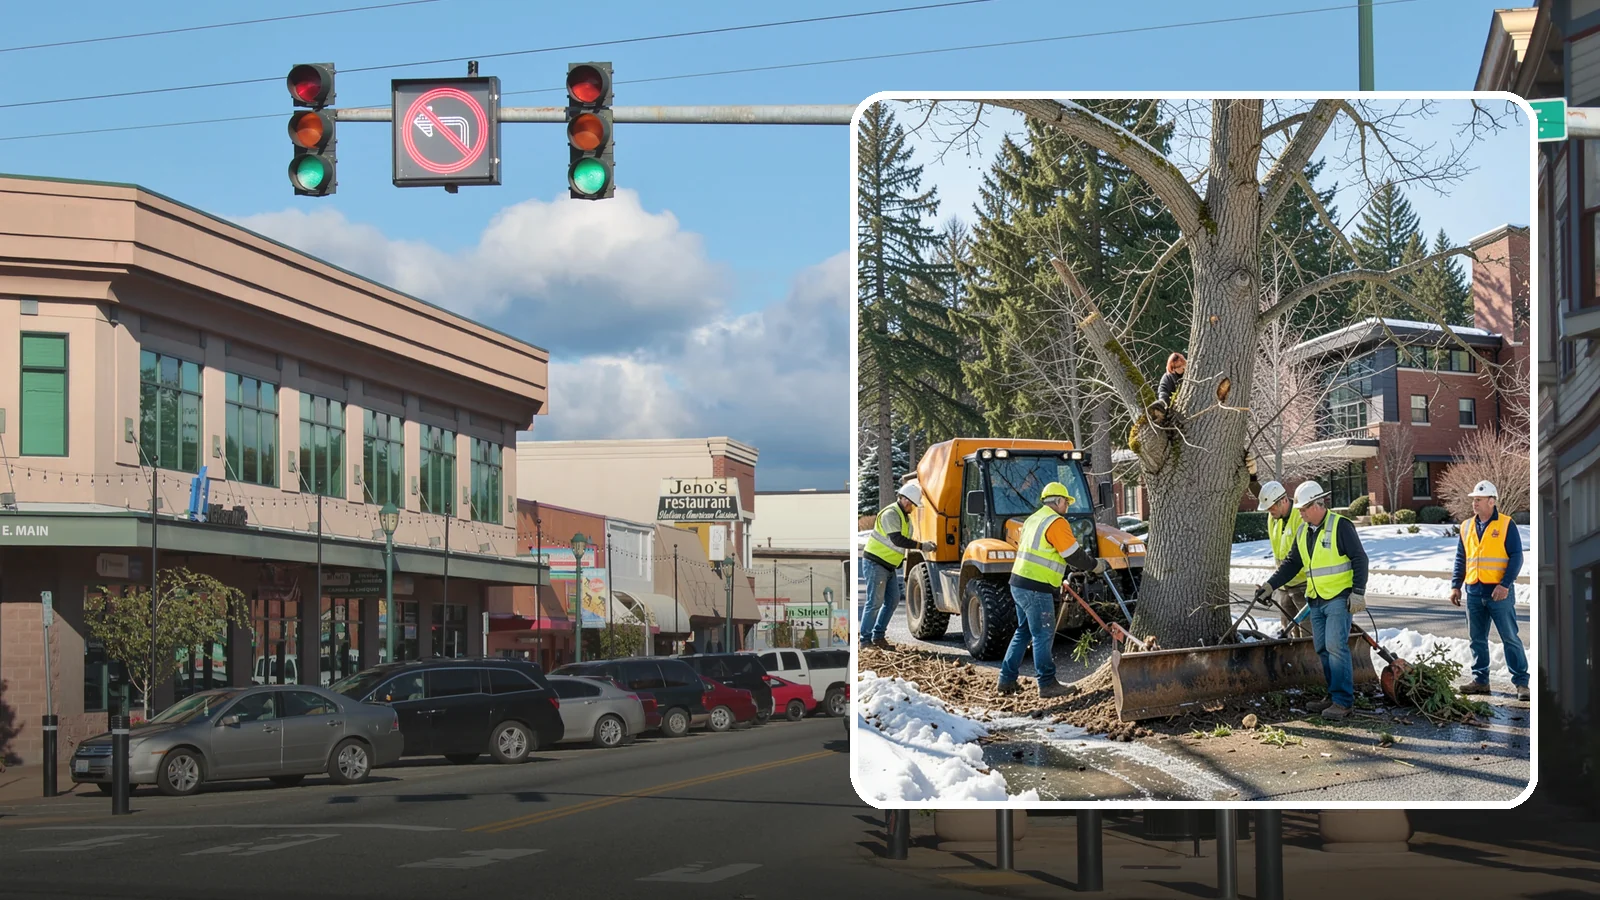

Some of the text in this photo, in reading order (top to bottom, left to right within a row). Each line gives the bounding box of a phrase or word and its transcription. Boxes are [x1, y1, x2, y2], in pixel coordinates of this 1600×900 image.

[669, 480, 727, 495] Jeno's
[665, 496, 731, 509] restaurant
[686, 509, 714, 519] American
[715, 509, 737, 519] Cuisine
[2, 525, 49, 536] E. MAIN
[797, 607, 828, 616] Street
[791, 619, 823, 627] lass
